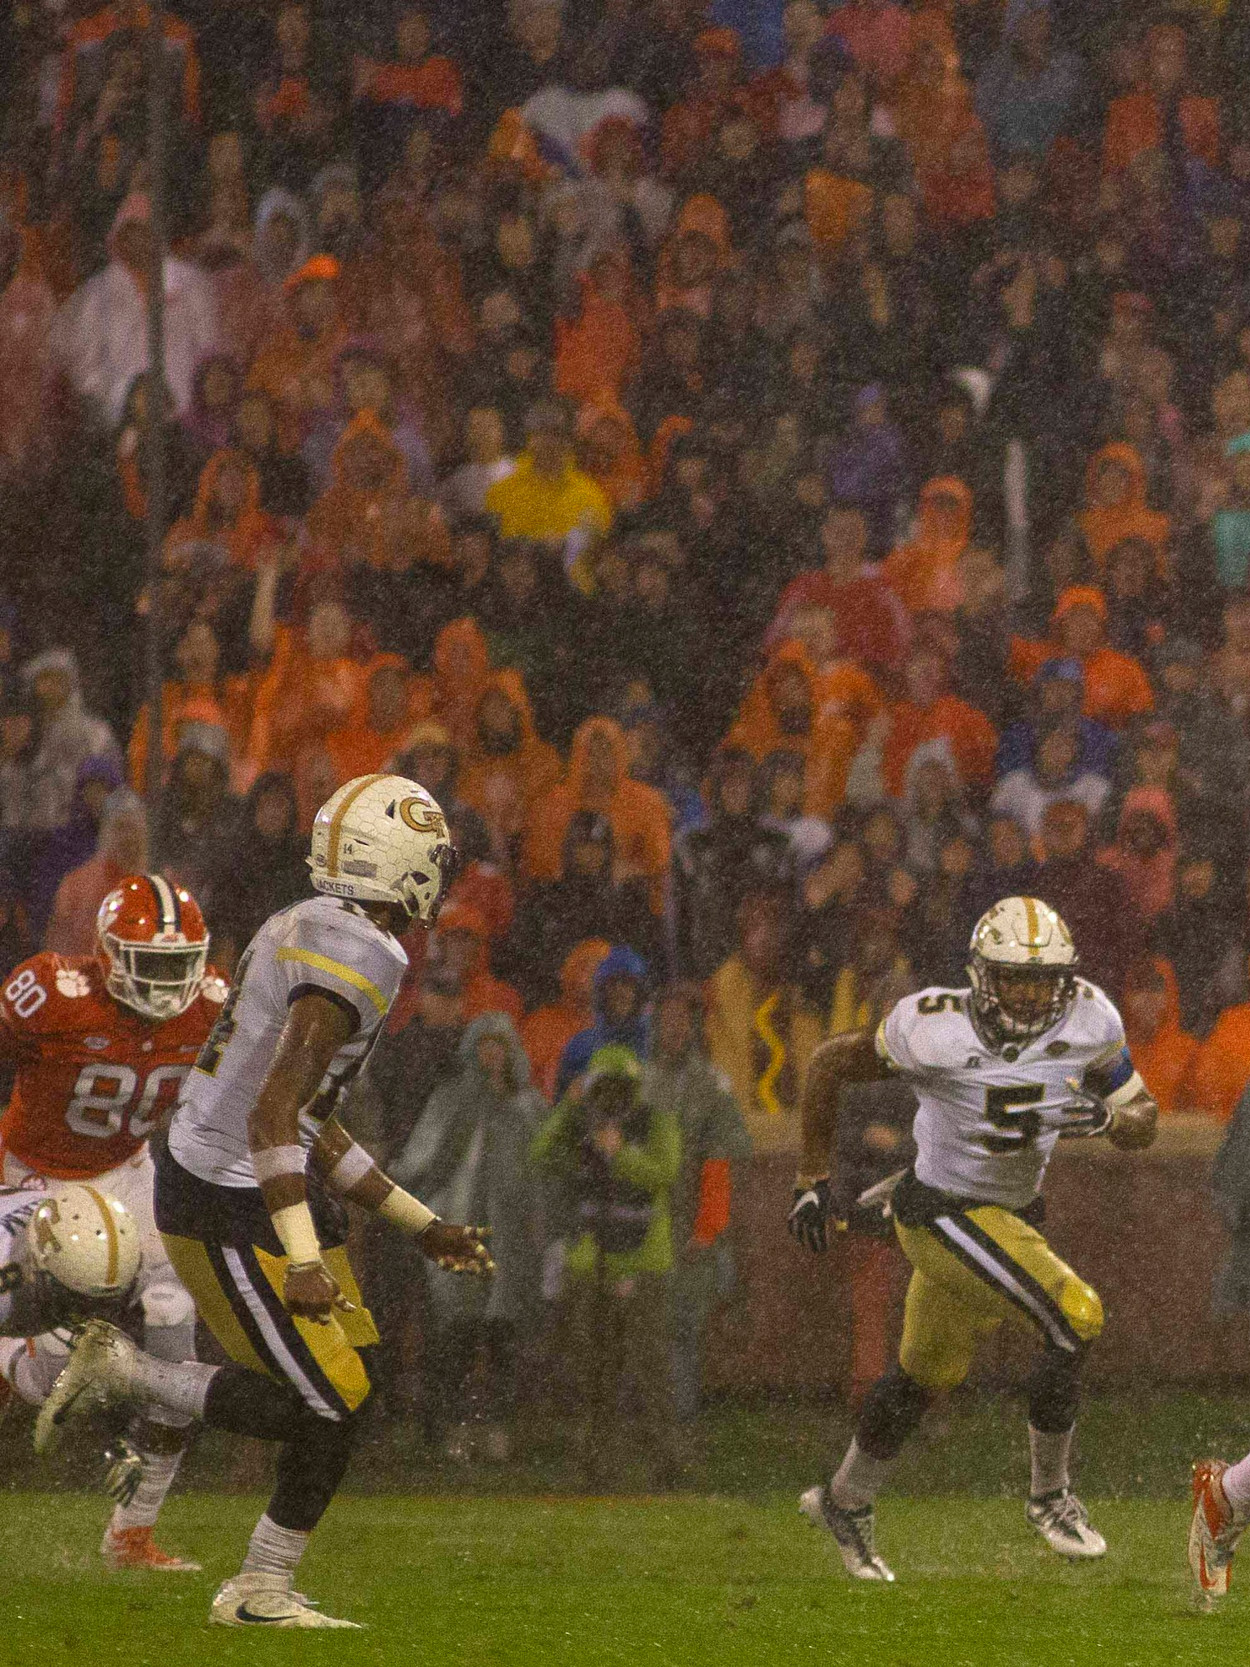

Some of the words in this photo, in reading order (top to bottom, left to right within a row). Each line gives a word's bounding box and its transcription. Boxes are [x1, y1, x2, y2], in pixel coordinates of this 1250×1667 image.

[343, 843, 353, 854] 14
[4, 969, 48, 1019] 80
[64, 1063, 196, 1139] 80
[969, 1082, 1046, 1153] 5
